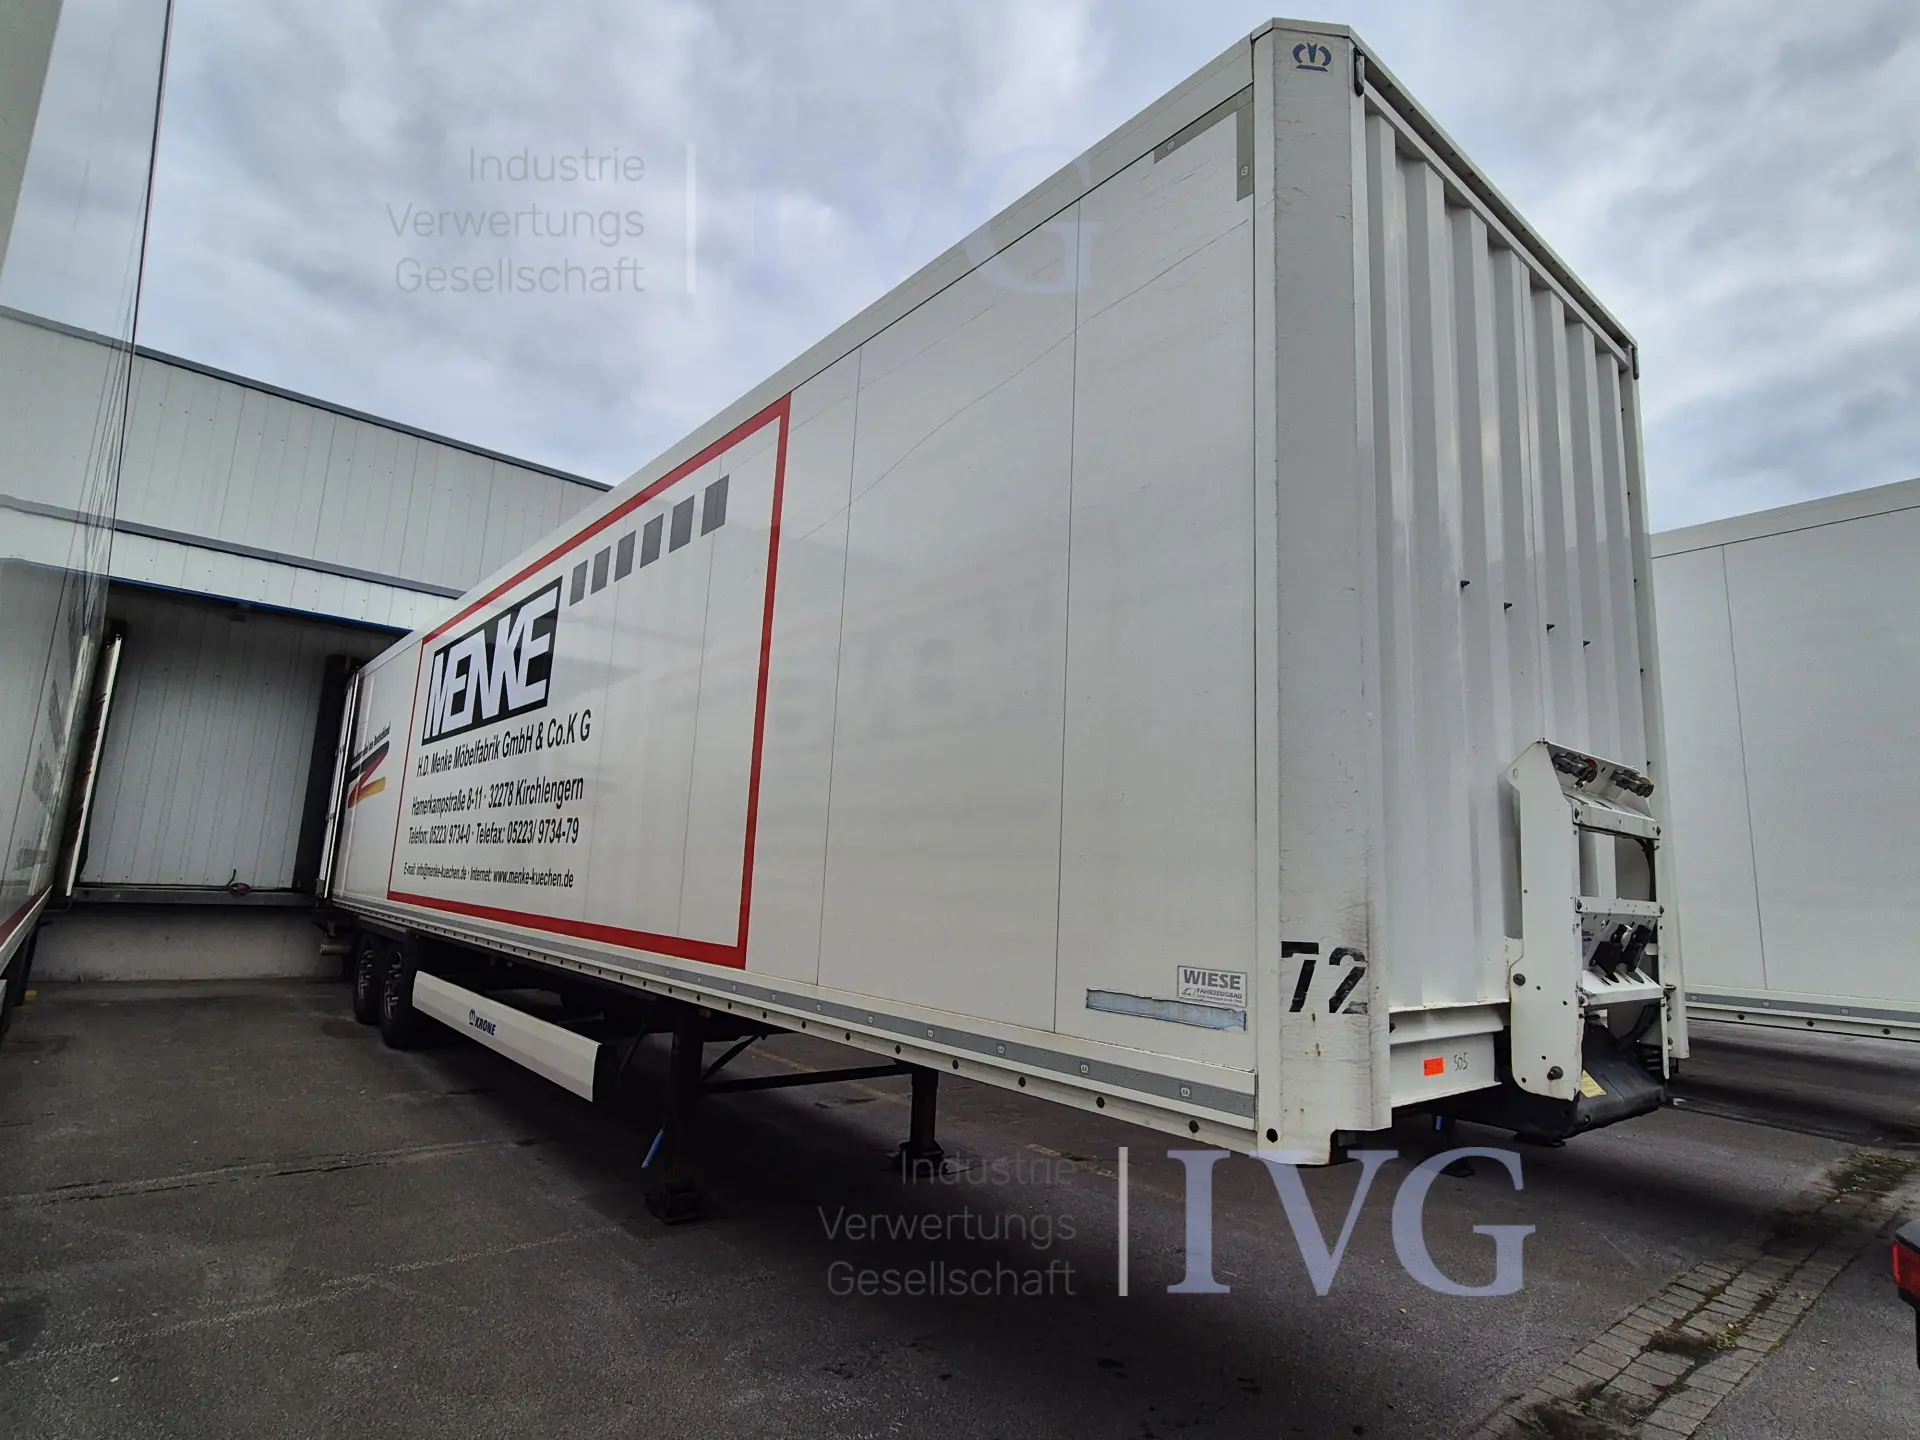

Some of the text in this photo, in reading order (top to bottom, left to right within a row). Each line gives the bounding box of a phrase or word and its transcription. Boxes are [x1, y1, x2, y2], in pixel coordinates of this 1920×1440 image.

[423, 587, 558, 740] MENKE
[417, 757, 429, 778] H.D.
[431, 752, 452, 775] Menke
[453, 734, 500, 769] Möbelfabrik
[502, 723, 534, 757] GmbH
[536, 721, 543, 751] &
[466, 785, 483, 812] 8-11
[488, 780, 514, 808] 32278
[515, 776, 584, 810] Kirchlengern
[408, 817, 580, 845] Telefon: 05223/ 9734-0 Telefax: 05223/ 9734-79
[470, 864, 493, 882] Internet:
[493, 867, 574, 888] www.menke-kuechen.de
[1183, 969, 1242, 991] WIESE
[1281, 940, 1368, 1015] 72
[1197, 988, 1243, 999] FAHRZEUGBAU
[474, 1016, 496, 1036] KRONE
[1453, 1052, 1469, 1072] 505
